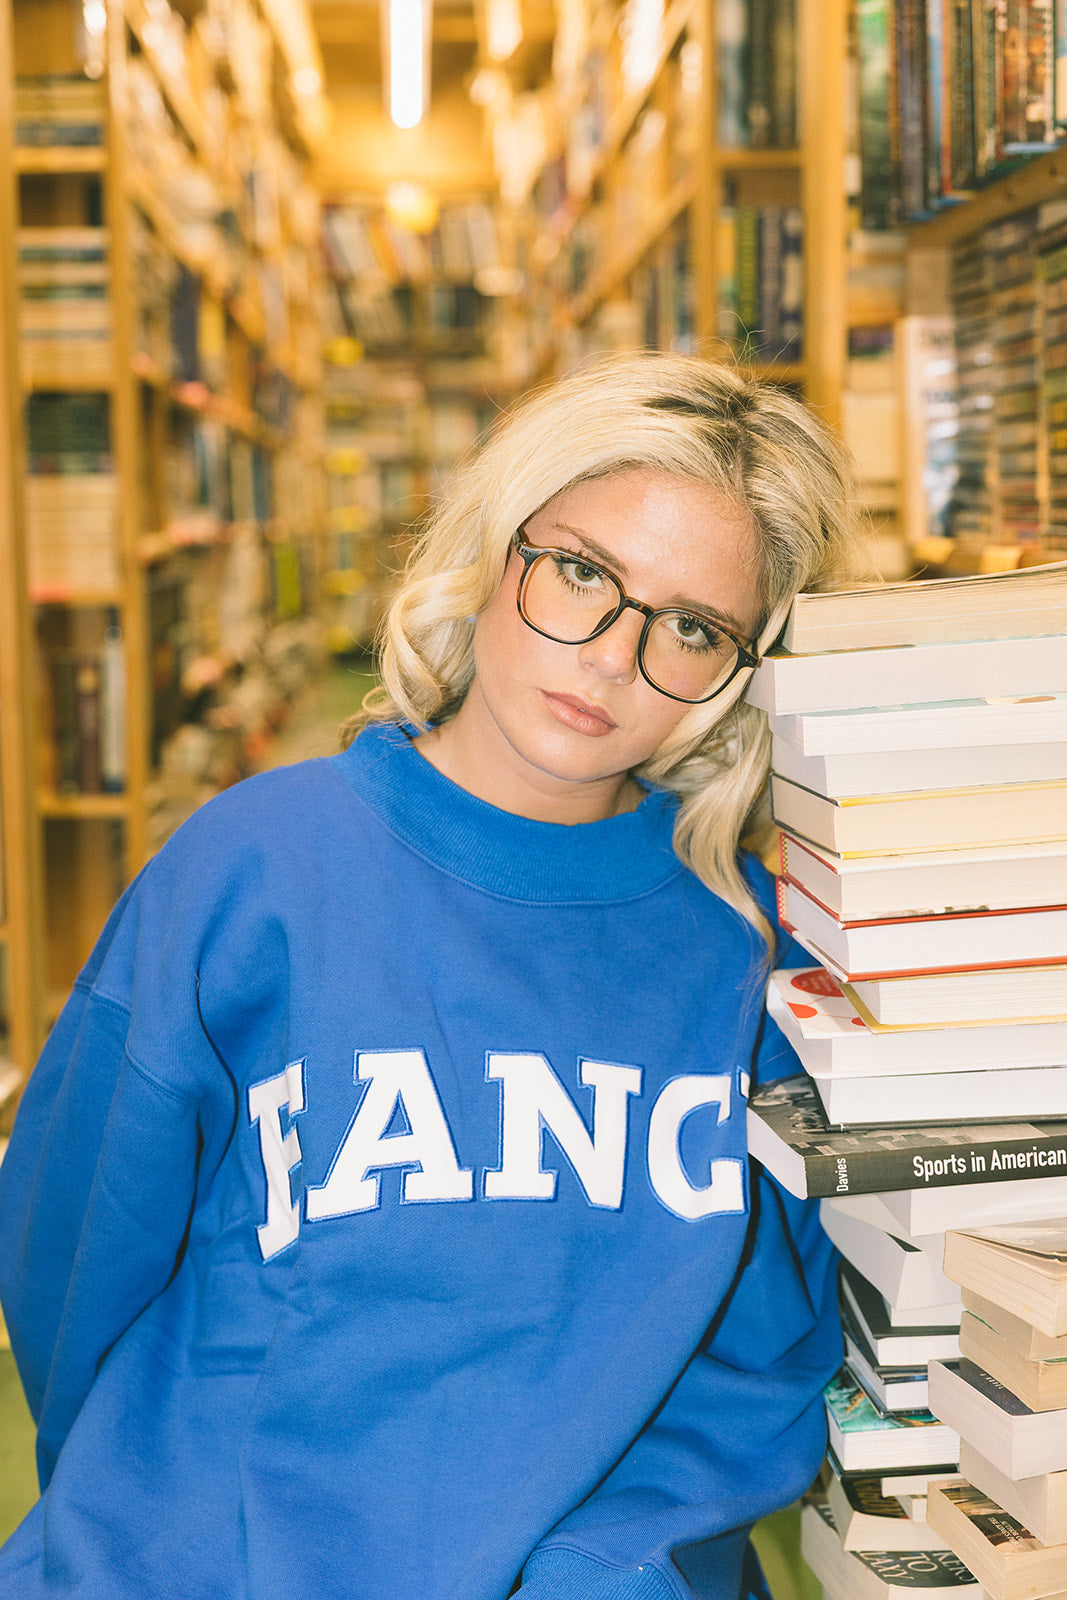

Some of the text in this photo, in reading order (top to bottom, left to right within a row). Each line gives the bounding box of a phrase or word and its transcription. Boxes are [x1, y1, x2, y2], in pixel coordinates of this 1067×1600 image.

[247, 1047, 750, 1263] FANC
[912, 1146, 1067, 1182] Sports in American
[836, 1157, 849, 1192] Davies
[856, 1550, 914, 1580] LAXY
[900, 1551, 938, 1573] TO
